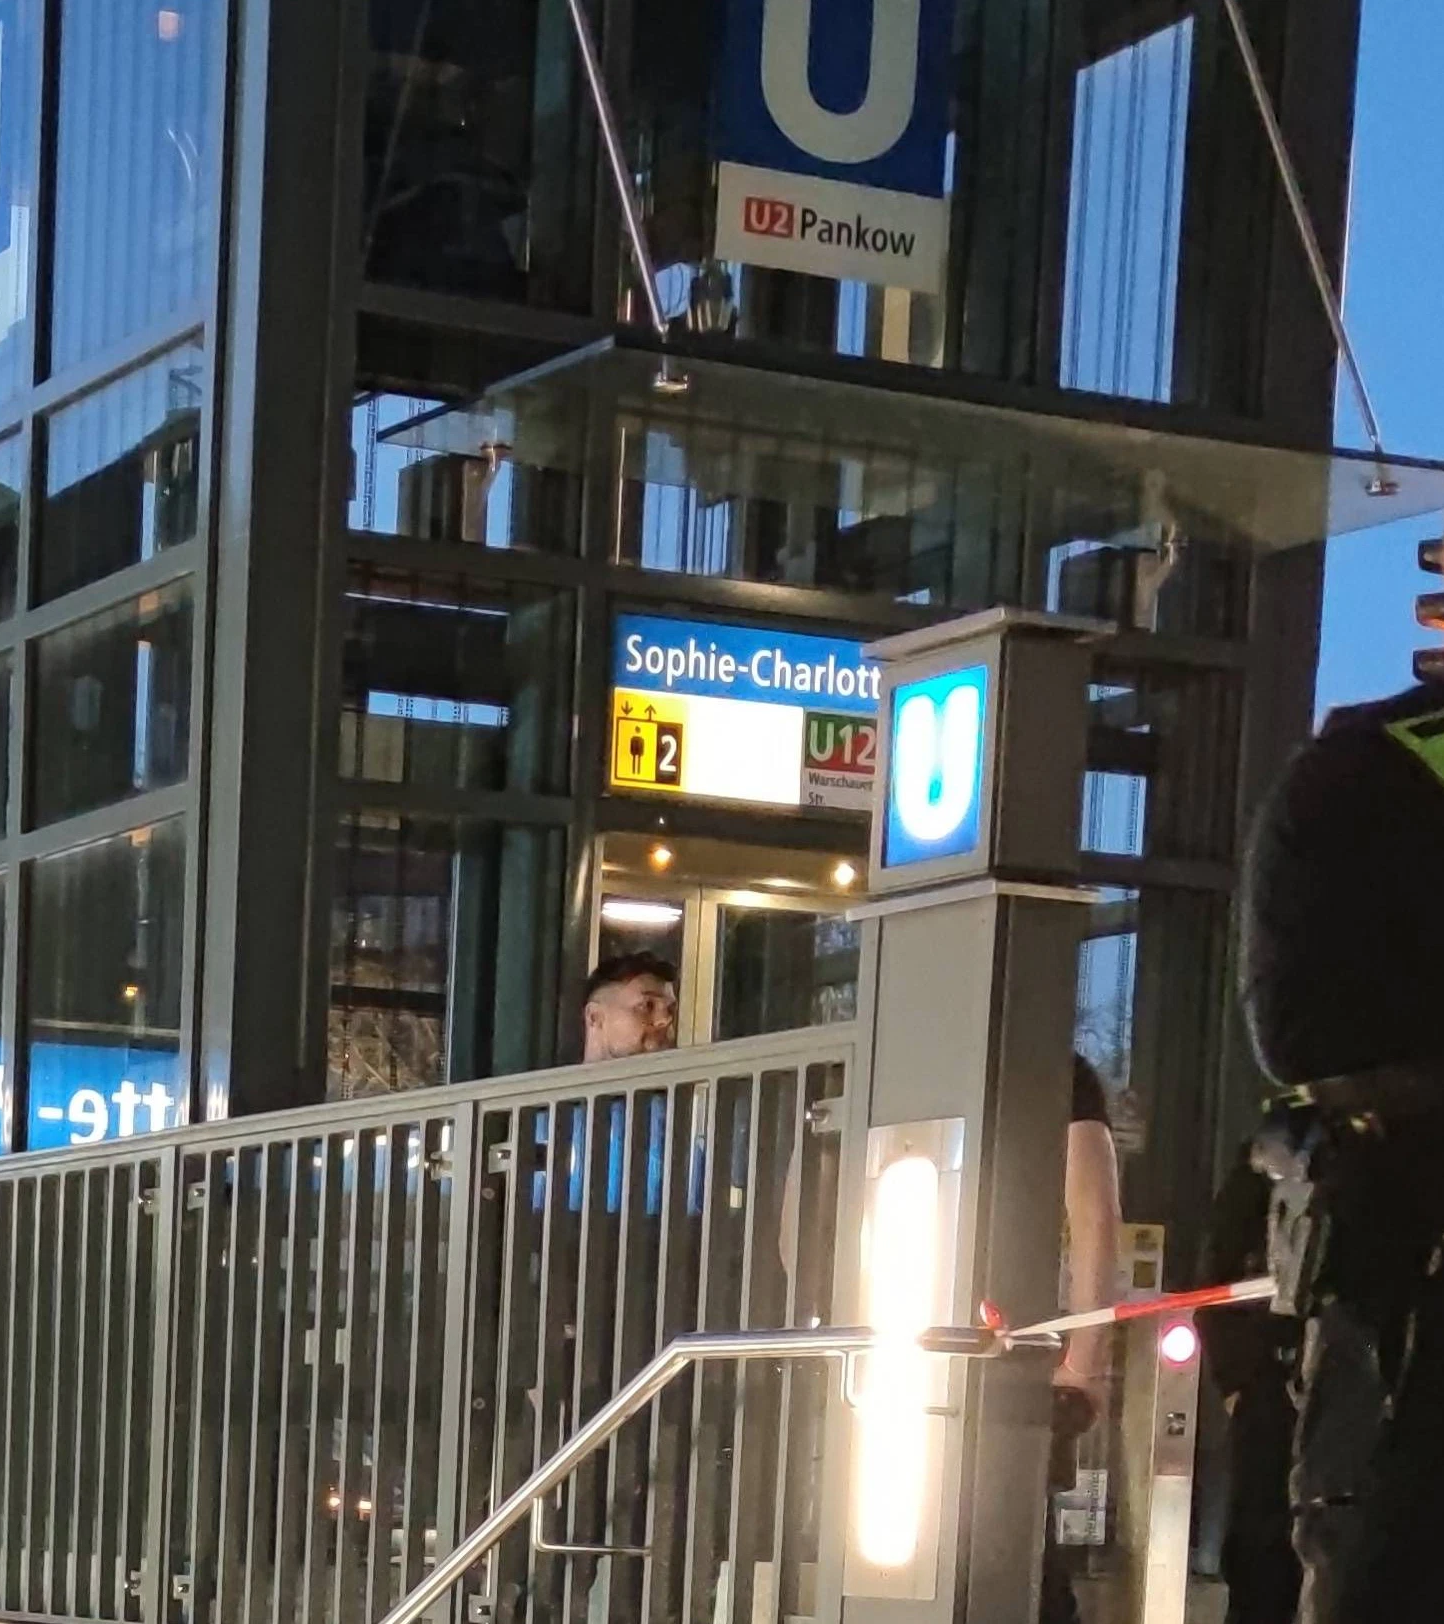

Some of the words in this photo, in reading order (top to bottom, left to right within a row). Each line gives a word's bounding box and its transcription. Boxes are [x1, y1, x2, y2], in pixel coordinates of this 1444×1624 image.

[761, 0, 920, 164] U
[749, 202, 791, 235] U2
[800, 208, 915, 257] Pankow
[659, 734, 678, 774] 2
[810, 719, 876, 768] U12
[896, 684, 980, 841] U
